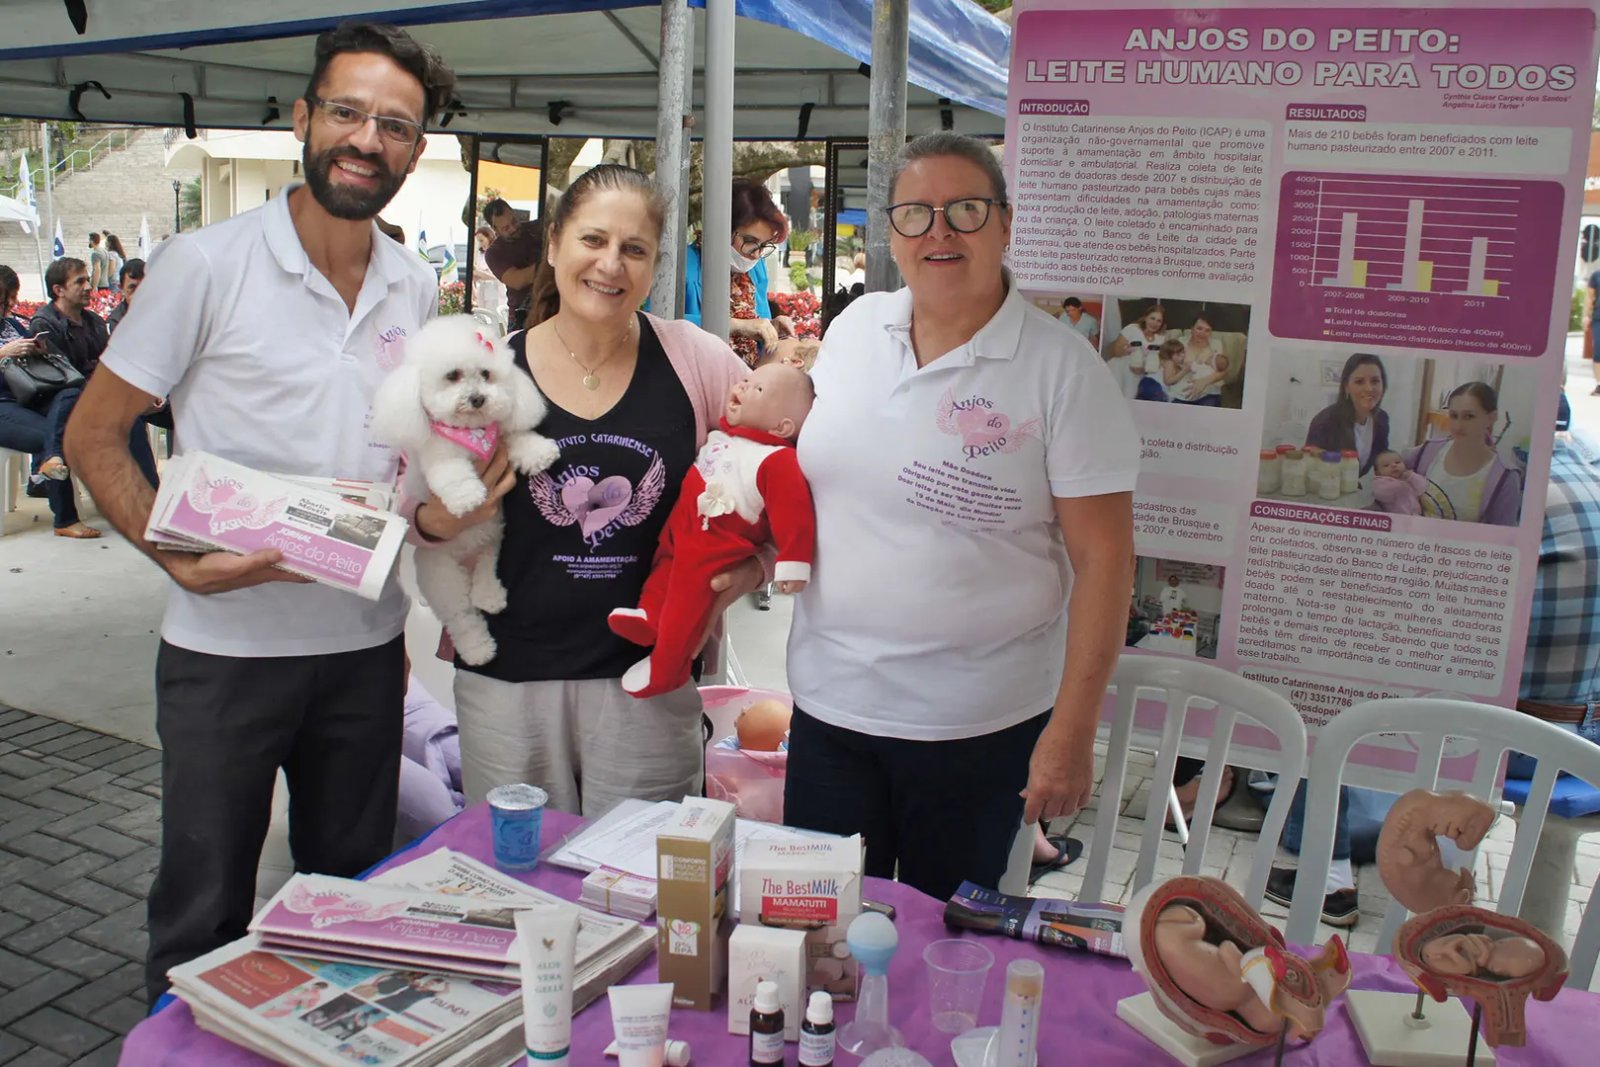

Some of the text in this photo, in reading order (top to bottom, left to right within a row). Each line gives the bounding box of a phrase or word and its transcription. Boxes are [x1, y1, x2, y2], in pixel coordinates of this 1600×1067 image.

[1124, 28, 1460, 52] ANJOS DO PEITO:
[1026, 60, 1576, 90] LEITE HUMANO PARA TODOS
[1020, 103, 1088, 115] INTRODUÇÃO
[1289, 108, 1365, 120] RESULTADOS
[1033, 123, 1069, 133] Instituto
[1071, 124, 1126, 134] Catarinense
[1128, 125, 1154, 136] Anjos
[1157, 126, 1169, 135] do
[1172, 126, 1196, 136] Peito
[1200, 127, 1232, 139] (ICAP)
[1288, 129, 1312, 139] Mais
[1314, 130, 1328, 139] de
[1330, 130, 1350, 140] 210
[1352, 131, 1384, 141] bebês
[1387, 132, 1416, 142] foram
[1420, 133, 1486, 144] beneficiados
[1516, 136, 1538, 146] leite
[1022, 135, 1264, 150] organização não-governamental que promove
[1287, 141, 1328, 152] humano
[1330, 143, 1396, 154] pasteurizado
[1399, 145, 1426, 155] entre
[1429, 146, 1454, 156] 2007
[1468, 147, 1496, 157] 2011.
[1020, 158, 1062, 168] domiciliar
[1081, 160, 1138, 170] ambulatorial.
[1146, 161, 1181, 171] Realiza
[1188, 163, 1216, 172] coleta
[1223, 163, 1236, 172] de
[1243, 164, 1262, 173] leite
[1020, 169, 1056, 179] humano
[1059, 170, 1071, 180] de
[1074, 171, 1117, 181] doadoras
[1120, 172, 1149, 182] desde
[1153, 173, 1176, 183] 2007
[1191, 174, 1245, 186] distribuição
[1249, 176, 1262, 186] de
[1019, 180, 1261, 198] leite humano pasteurizado para bebês cujas mães
[949, 395, 994, 417] Anjos
[987, 417, 1002, 428] do
[591, 433, 653, 458] CATARINENSE
[1147, 439, 1174, 448] coleta
[1185, 442, 1238, 455] distribuição
[551, 464, 600, 494] Anjos
[903, 467, 935, 483] Obrigado
[936, 478, 949, 489] por
[913, 461, 926, 470] Seu
[929, 466, 945, 476] leite
[948, 473, 960, 481] me
[1133, 502, 1196, 515] cadastros das
[1254, 505, 1389, 529] CONSIDERAÇÕES FINAIS
[1172, 517, 1211, 529] Brusque
[1142, 524, 1166, 534] 2007
[1177, 529, 1223, 542] dezembro
[1251, 522, 1285, 534] Apesar
[1288, 526, 1300, 536] do
[1303, 528, 1358, 542] incremento
[1376, 537, 1414, 549] número
[1417, 541, 1430, 551] de
[1434, 543, 1471, 556] frascos
[1474, 548, 1487, 558] de
[1490, 550, 1512, 561] leite
[264, 533, 303, 554] Anjos
[305, 546, 325, 560] do
[327, 552, 361, 573] Peito
[1246, 570, 1505, 609] bebês podem ser beneficiados com leite humano
[1239, 625, 1268, 637] bebês
[1274, 629, 1293, 640] têm
[1298, 633, 1328, 645] direito
[1334, 638, 1347, 647] de
[1353, 642, 1390, 654] receber
[1409, 650, 1444, 661] melhor
[1450, 654, 1497, 670] alimento,
[1242, 671, 1379, 700] Instituto Catarinense Anjos do
[1290, 690, 1352, 707] (47) 33517786
[762, 878, 838, 896] The BestMilk
[773, 898, 826, 908] MAMATUTTI
[381, 921, 507, 945] Anjos do Peito
